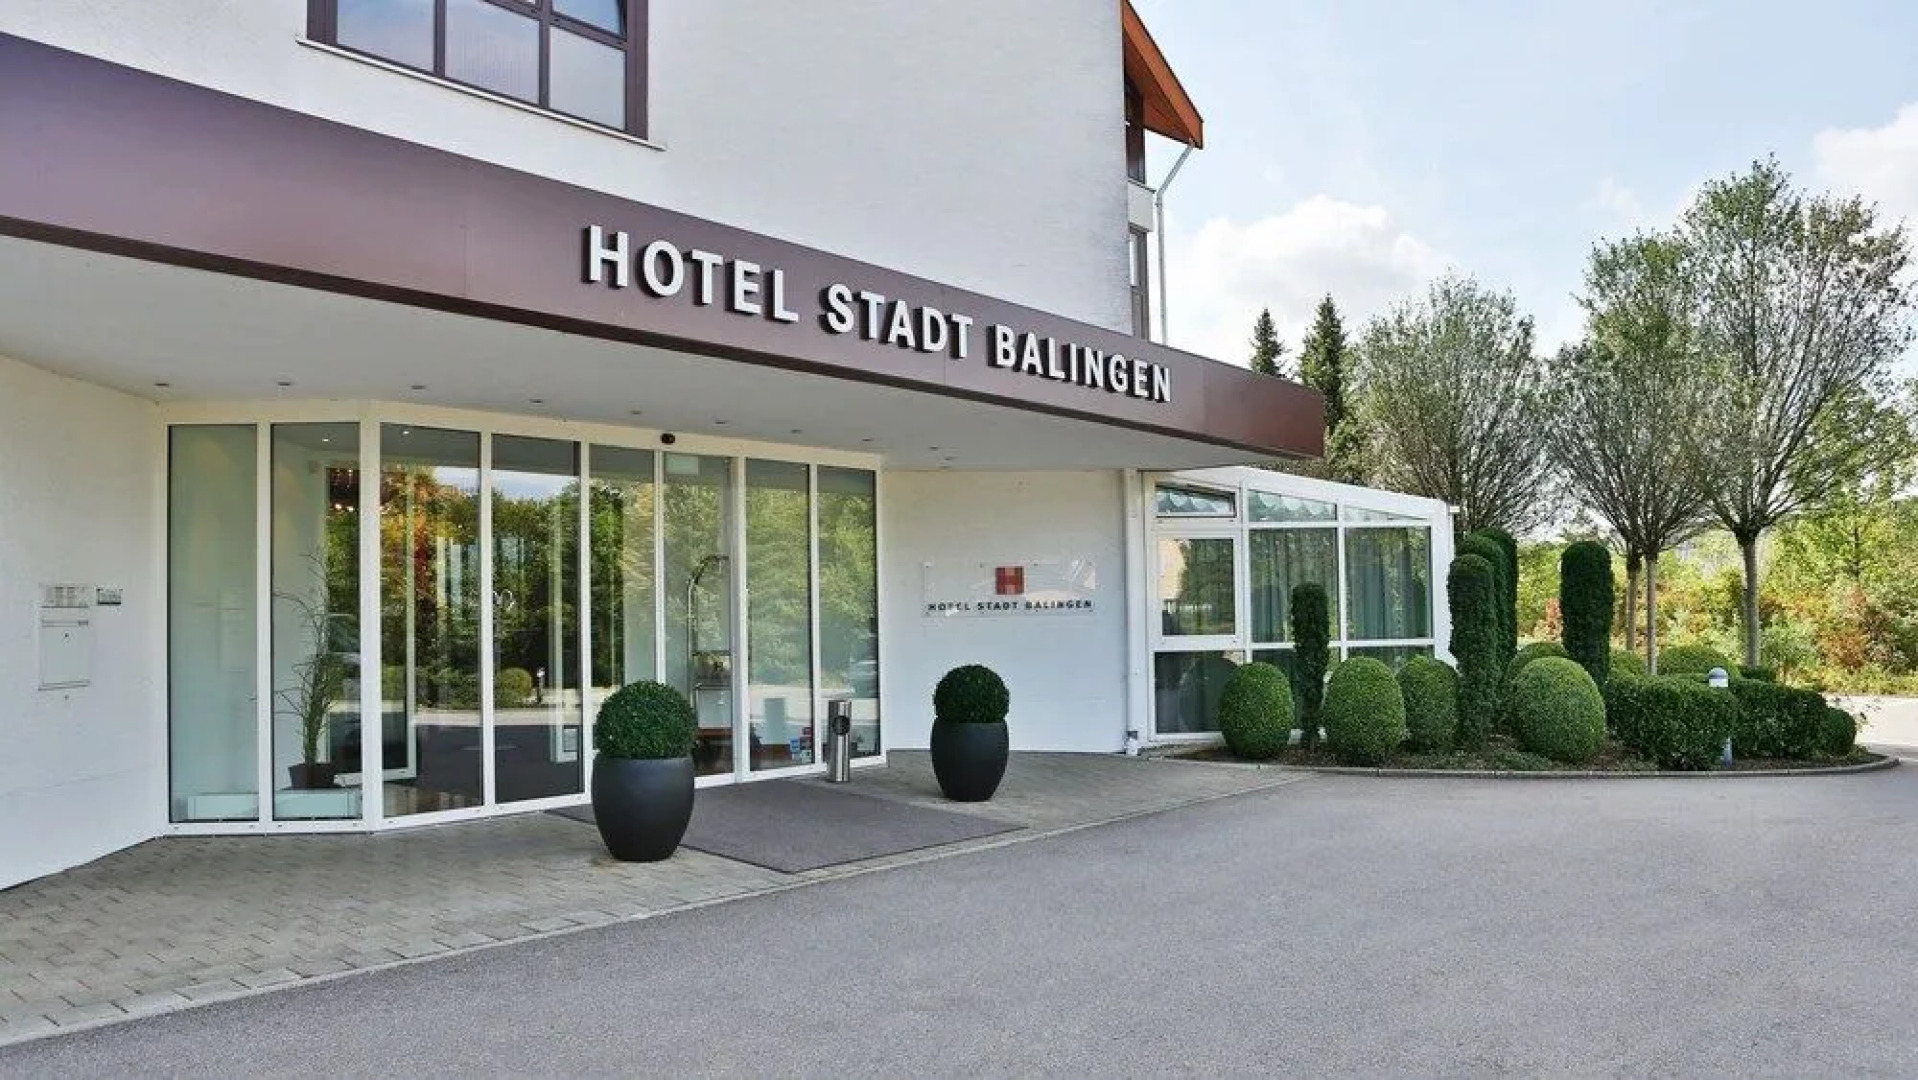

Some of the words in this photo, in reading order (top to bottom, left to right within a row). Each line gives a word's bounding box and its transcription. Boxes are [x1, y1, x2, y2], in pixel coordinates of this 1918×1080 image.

[586, 224, 799, 323] HOTEL
[822, 283, 973, 359] STADT
[991, 323, 1171, 402] BALINGEN
[927, 602, 971, 611] HOTEL
[977, 601, 1019, 611] STADT
[1025, 600, 1092, 610] BALINGEN
